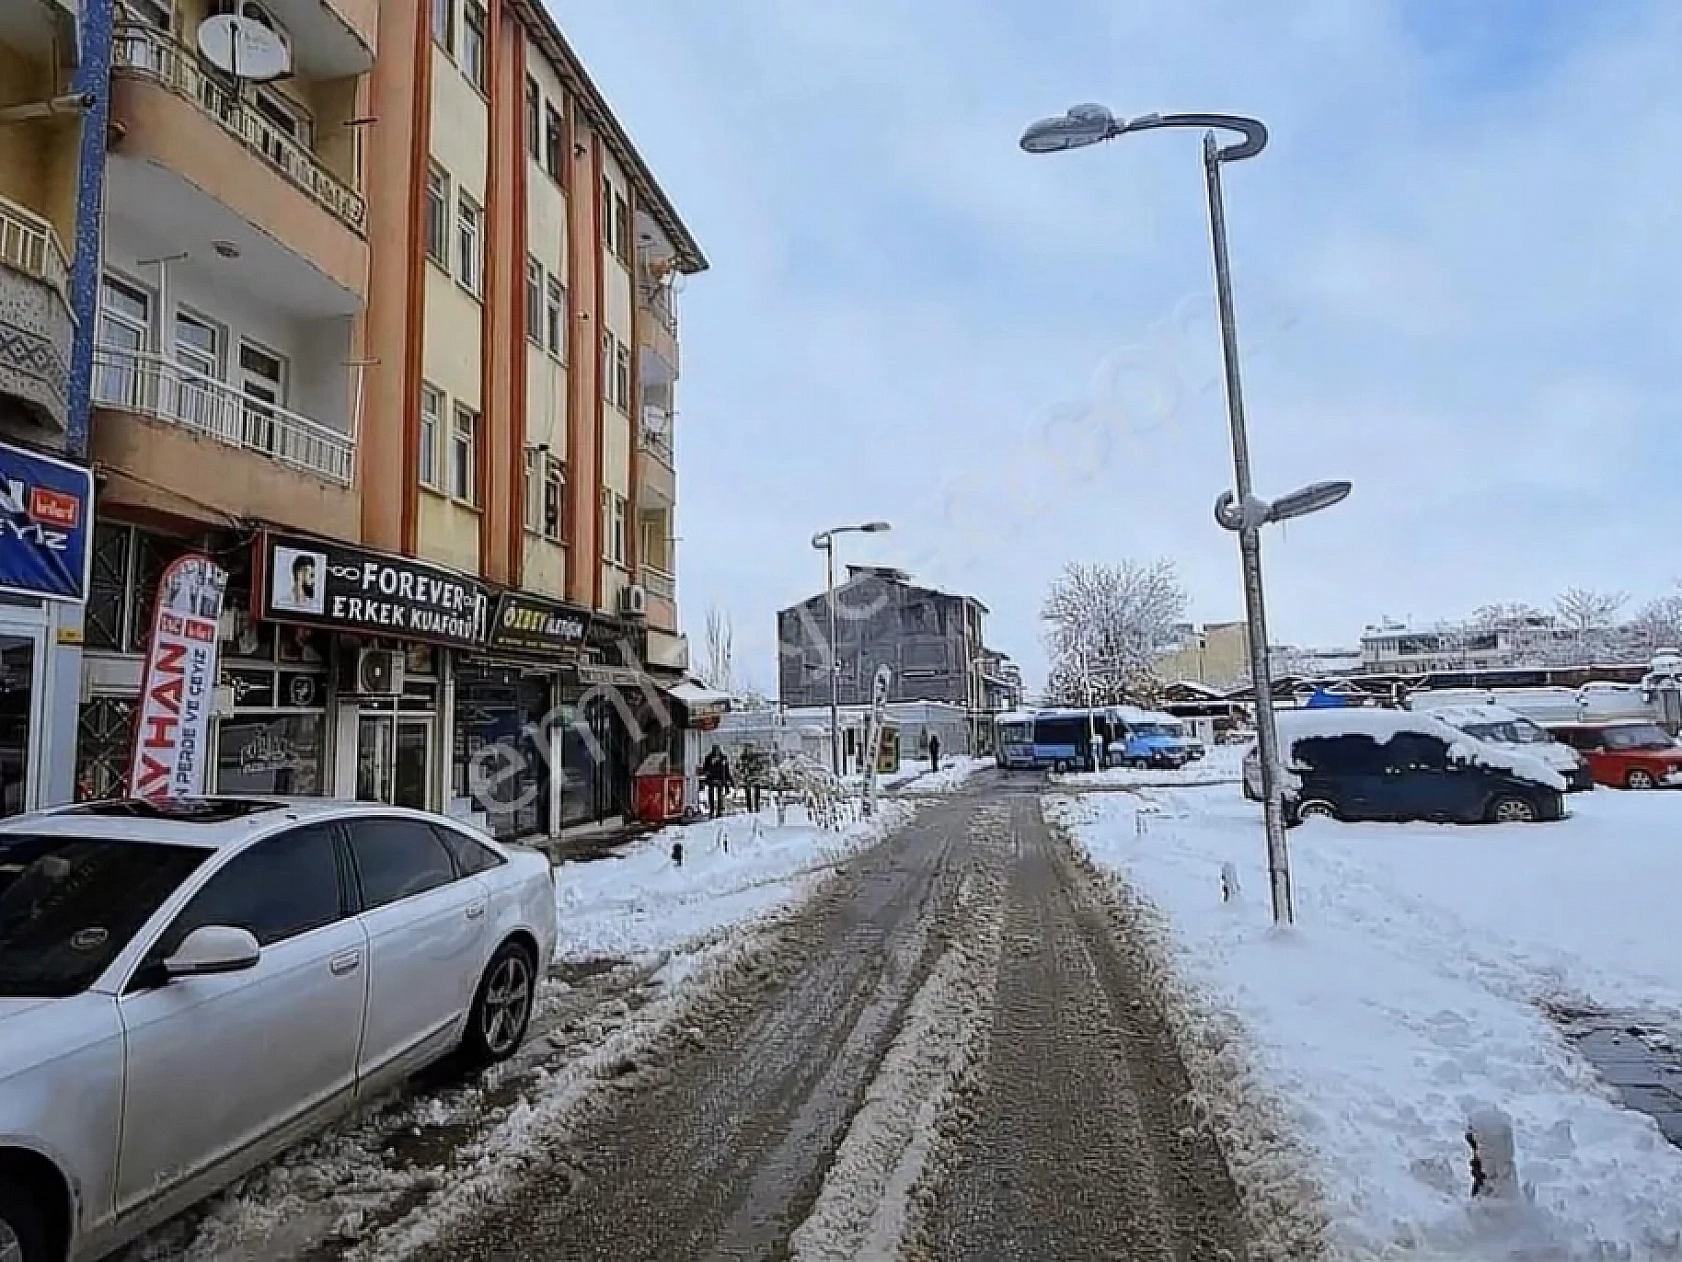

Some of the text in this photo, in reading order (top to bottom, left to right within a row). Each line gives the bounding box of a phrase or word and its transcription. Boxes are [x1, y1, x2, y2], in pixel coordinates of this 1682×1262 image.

[333, 595, 405, 627] ERKEK
[362, 562, 464, 611] FOREVER
[176, 727, 196, 784] PERDE
